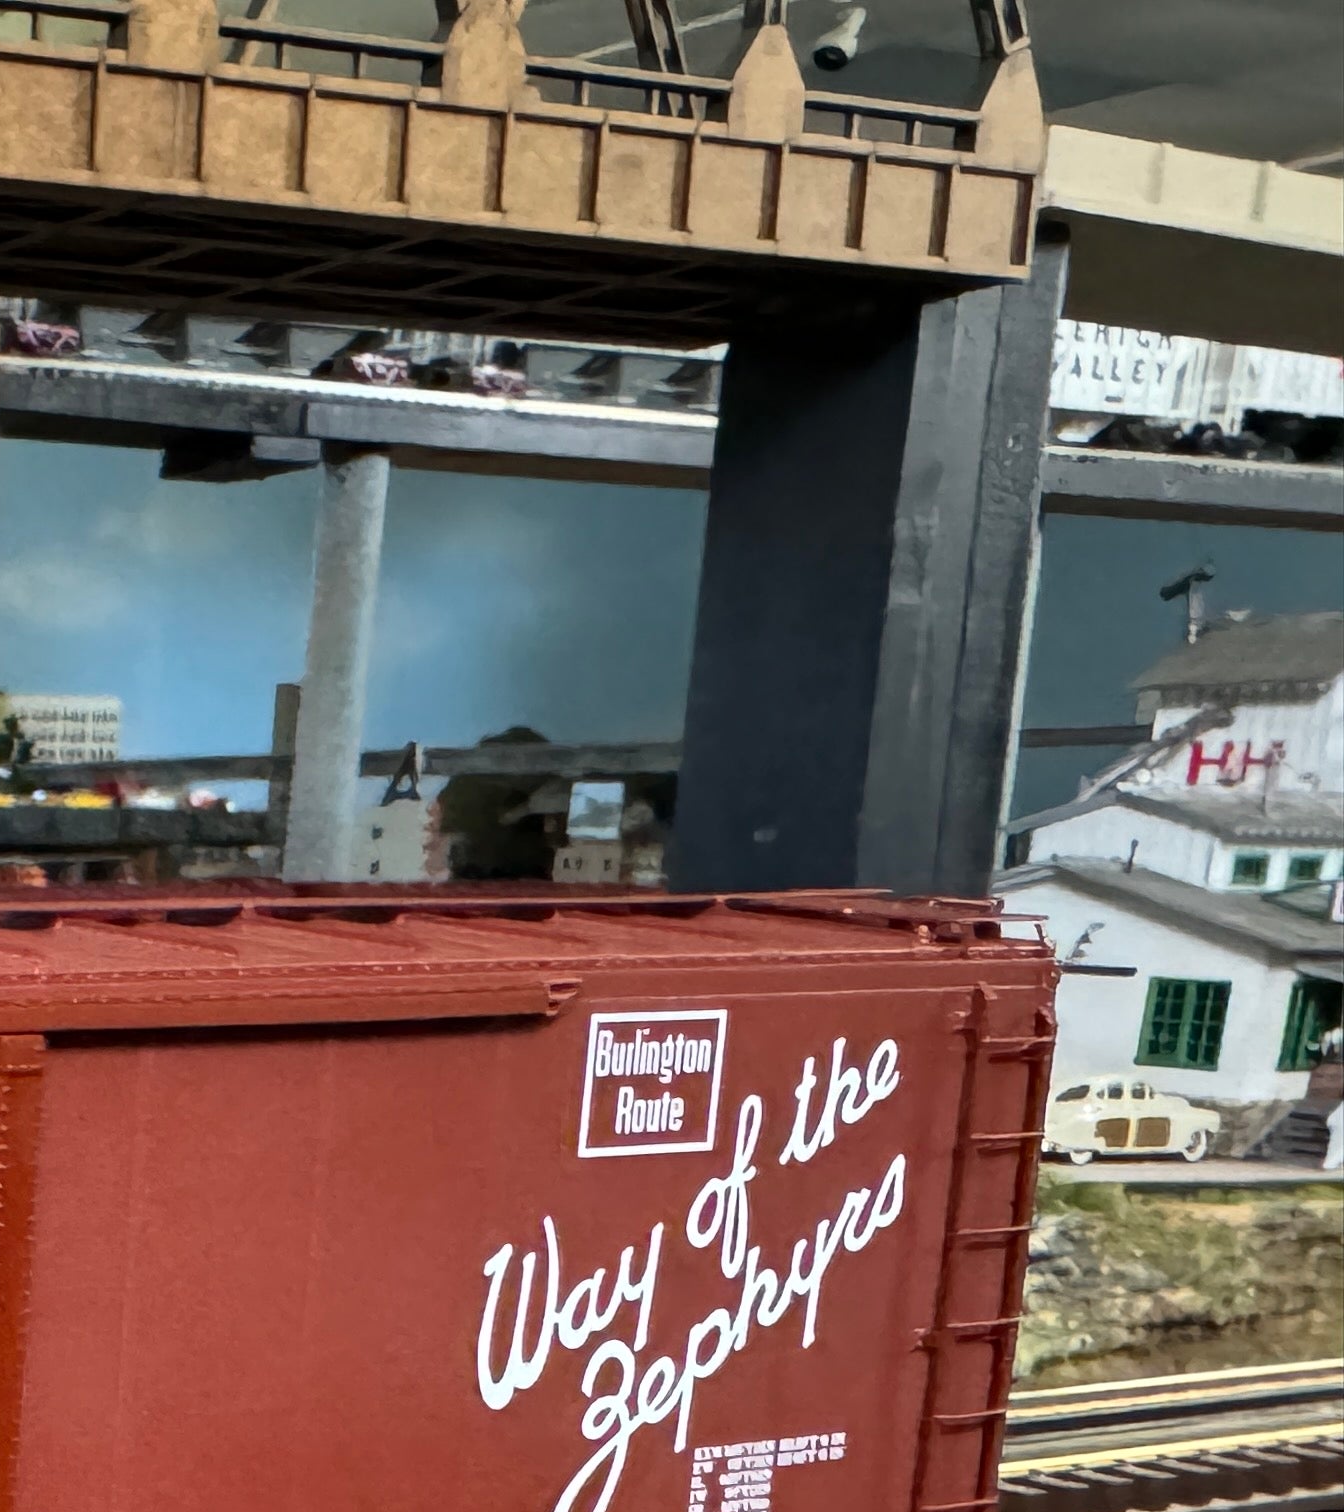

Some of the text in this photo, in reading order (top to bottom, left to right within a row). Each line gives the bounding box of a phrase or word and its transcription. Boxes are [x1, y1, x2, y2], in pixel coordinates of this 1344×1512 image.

[1052, 353, 1168, 384] ALLEY
[594, 1027, 713, 1085] Burlington
[614, 1085, 685, 1135] Route
[477, 1036, 901, 1411] Way of the
